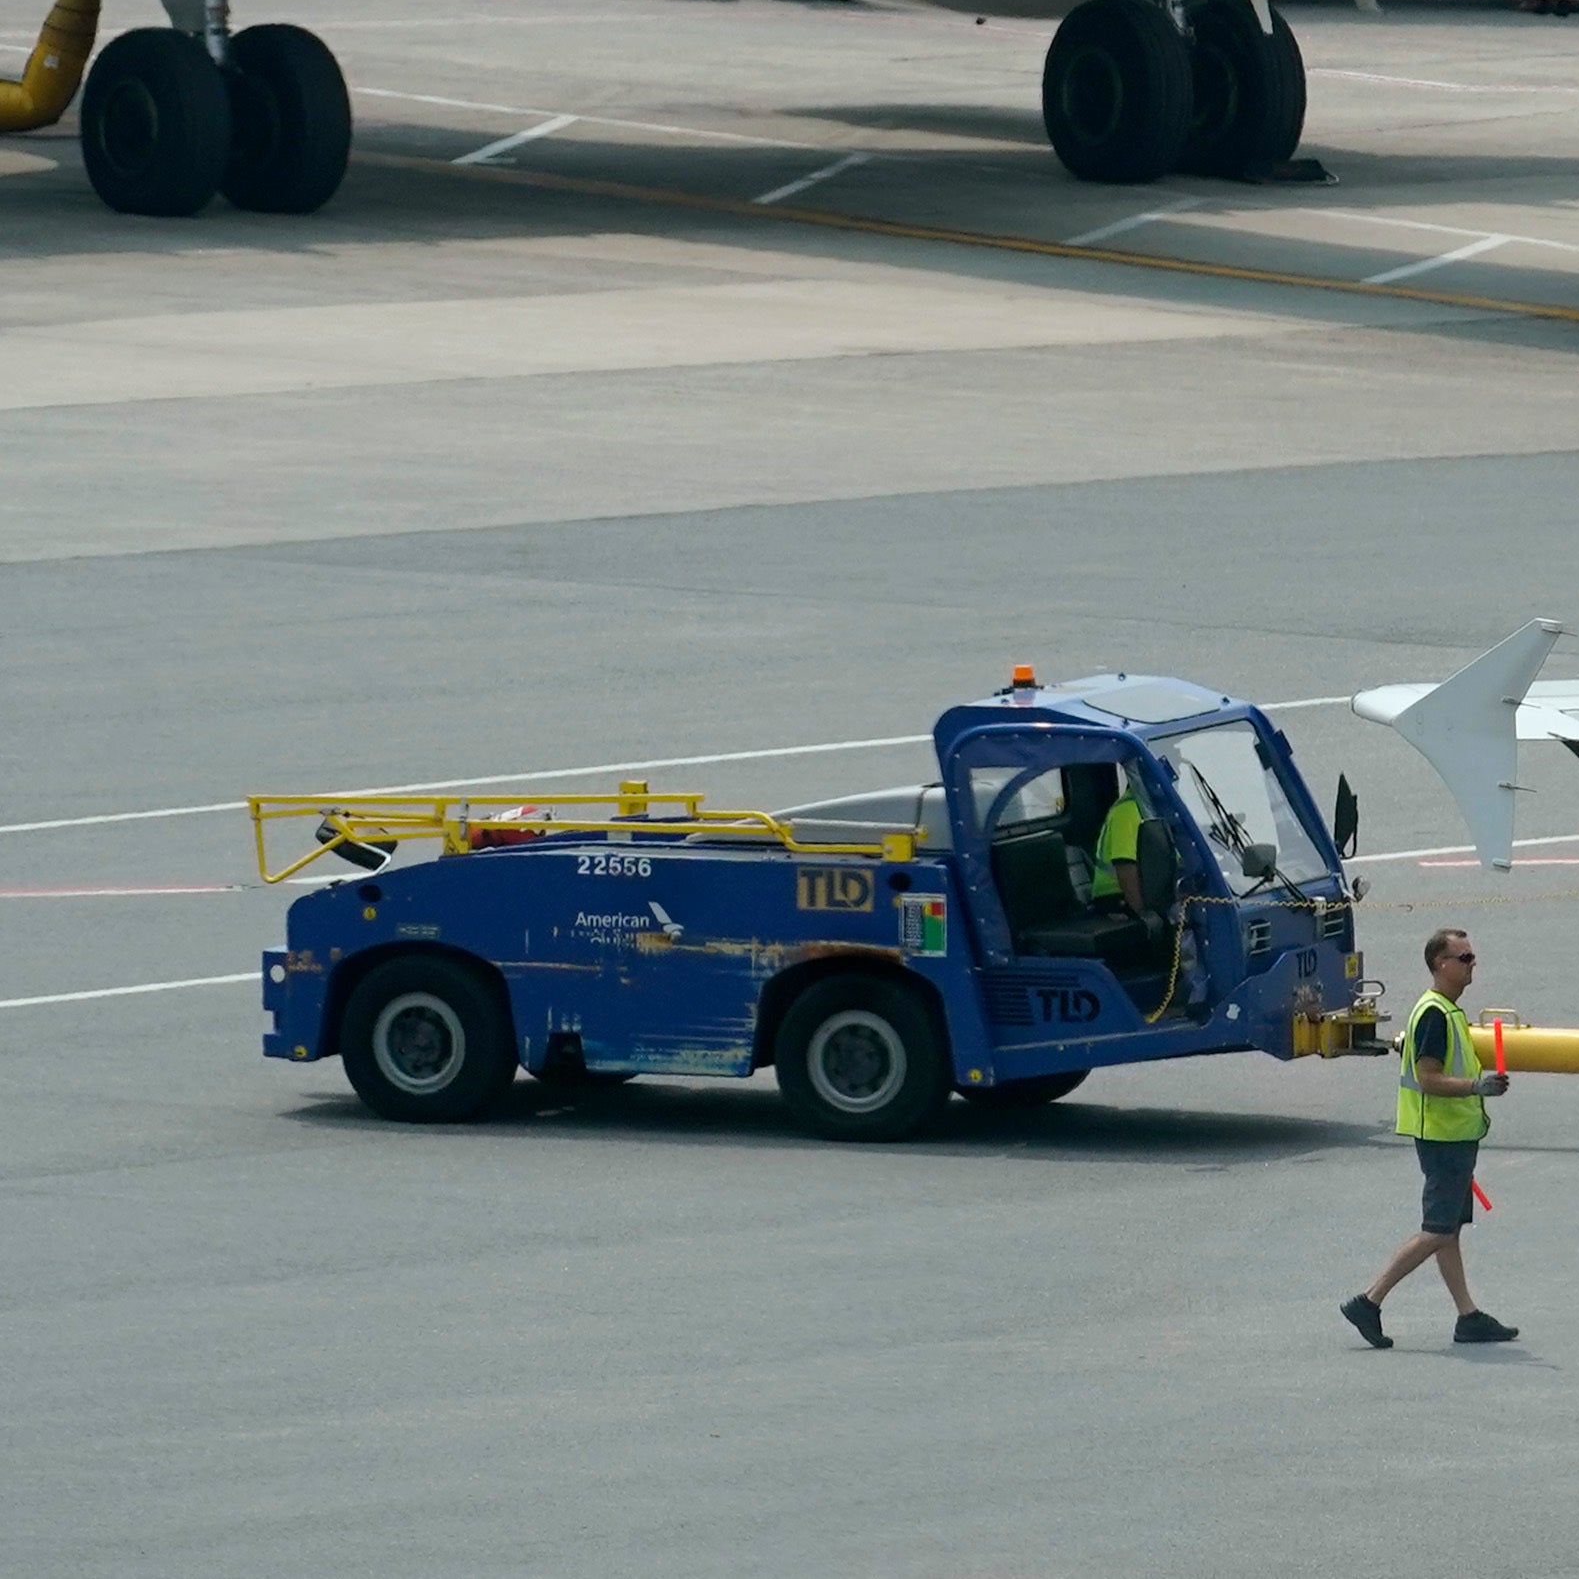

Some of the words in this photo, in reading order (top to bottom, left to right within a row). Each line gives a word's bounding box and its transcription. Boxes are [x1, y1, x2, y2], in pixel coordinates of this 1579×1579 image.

[577, 855, 652, 878] 22556
[801, 870, 869, 909] TLD
[574, 911, 650, 929] American
[1296, 949, 1317, 978] TLD
[1036, 989, 1100, 1022] TLD
